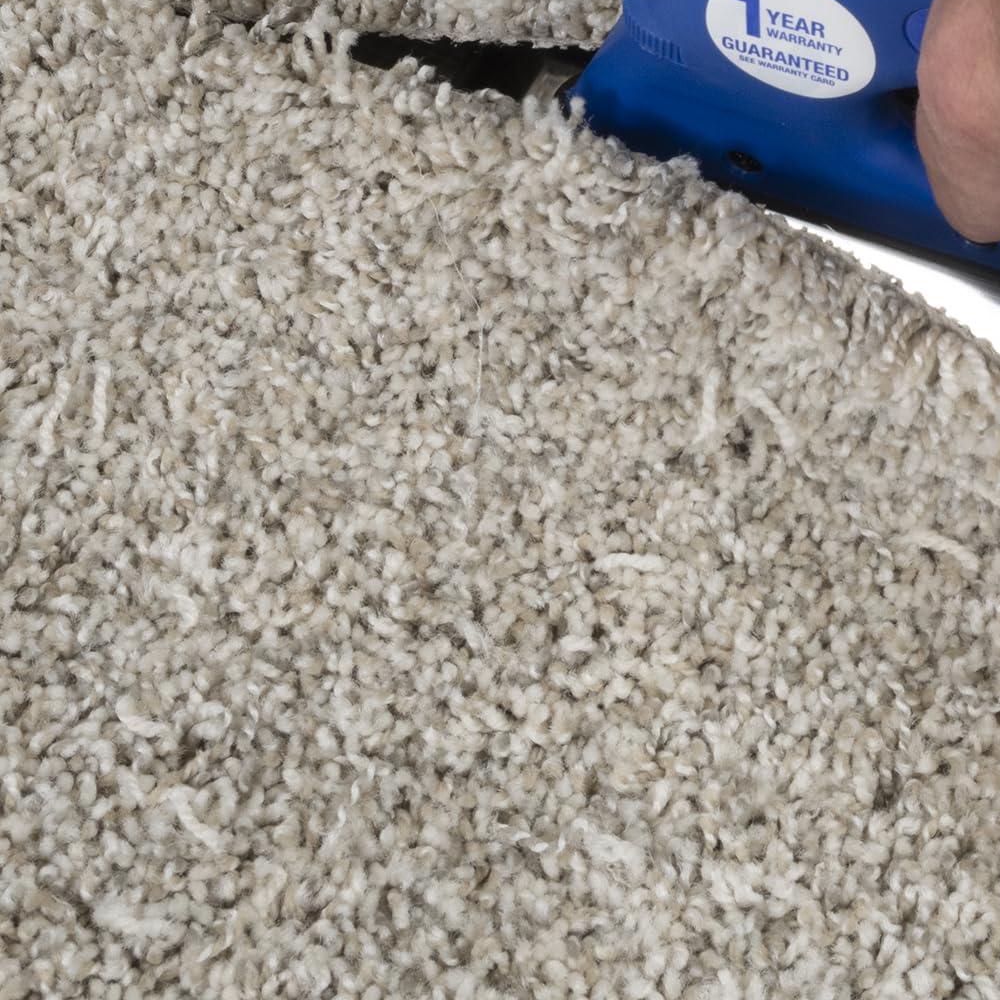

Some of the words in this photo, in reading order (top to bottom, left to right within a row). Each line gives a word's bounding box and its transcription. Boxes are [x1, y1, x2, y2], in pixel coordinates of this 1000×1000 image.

[766, 8, 825, 38] YEAR
[766, 27, 843, 57] WARRANTY
[721, 35, 850, 82] GUARANTEED
[739, 54, 756, 65] SEE
[757, 59, 808, 79] WARRANTY
[810, 73, 836, 87] CARD
